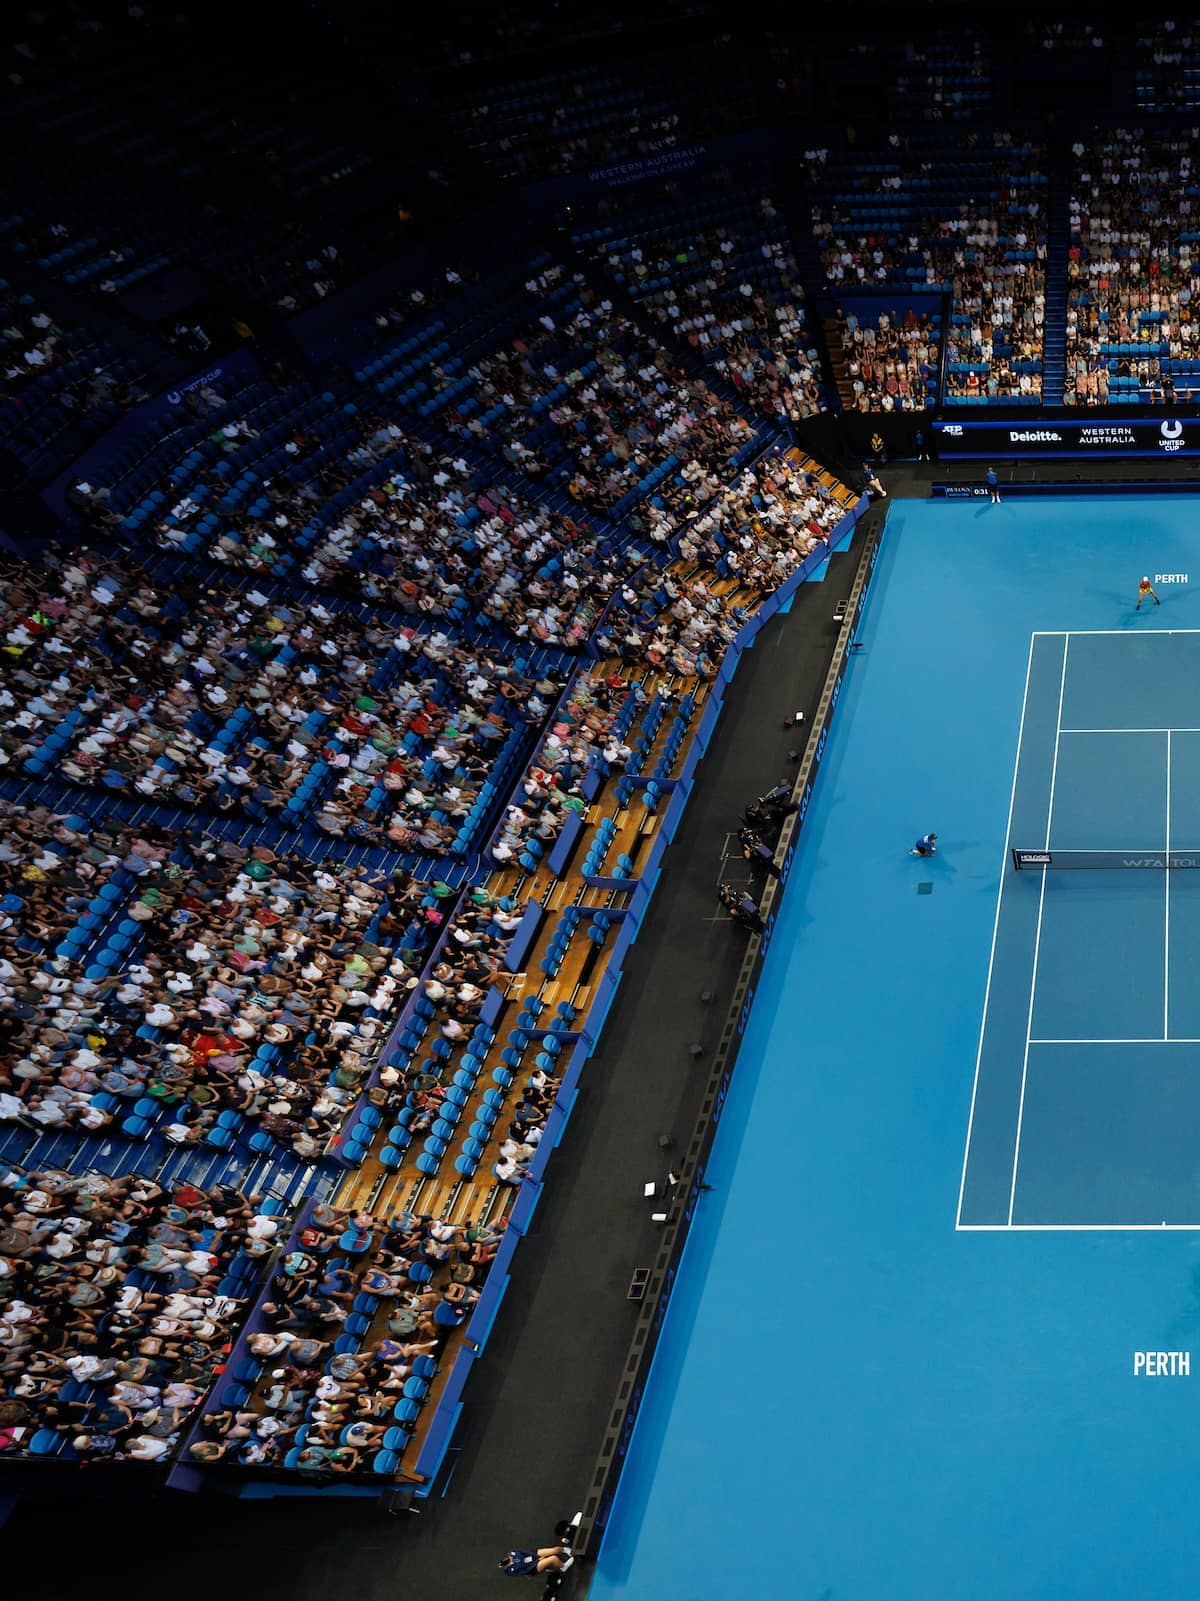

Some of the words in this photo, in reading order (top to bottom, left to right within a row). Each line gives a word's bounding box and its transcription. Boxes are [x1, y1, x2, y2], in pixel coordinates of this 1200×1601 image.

[586, 160, 642, 181] WESTERN
[647, 145, 706, 167] AUSTRALIA
[1010, 431, 1062, 442] Deloitte.
[1081, 428, 1132, 436] WESTERN
[1079, 436, 1136, 444] AUSTRALIA
[1154, 574, 1188, 583] PERTH
[1122, 858, 1164, 867] WTA
[1134, 1351, 1190, 1376] PERTH
